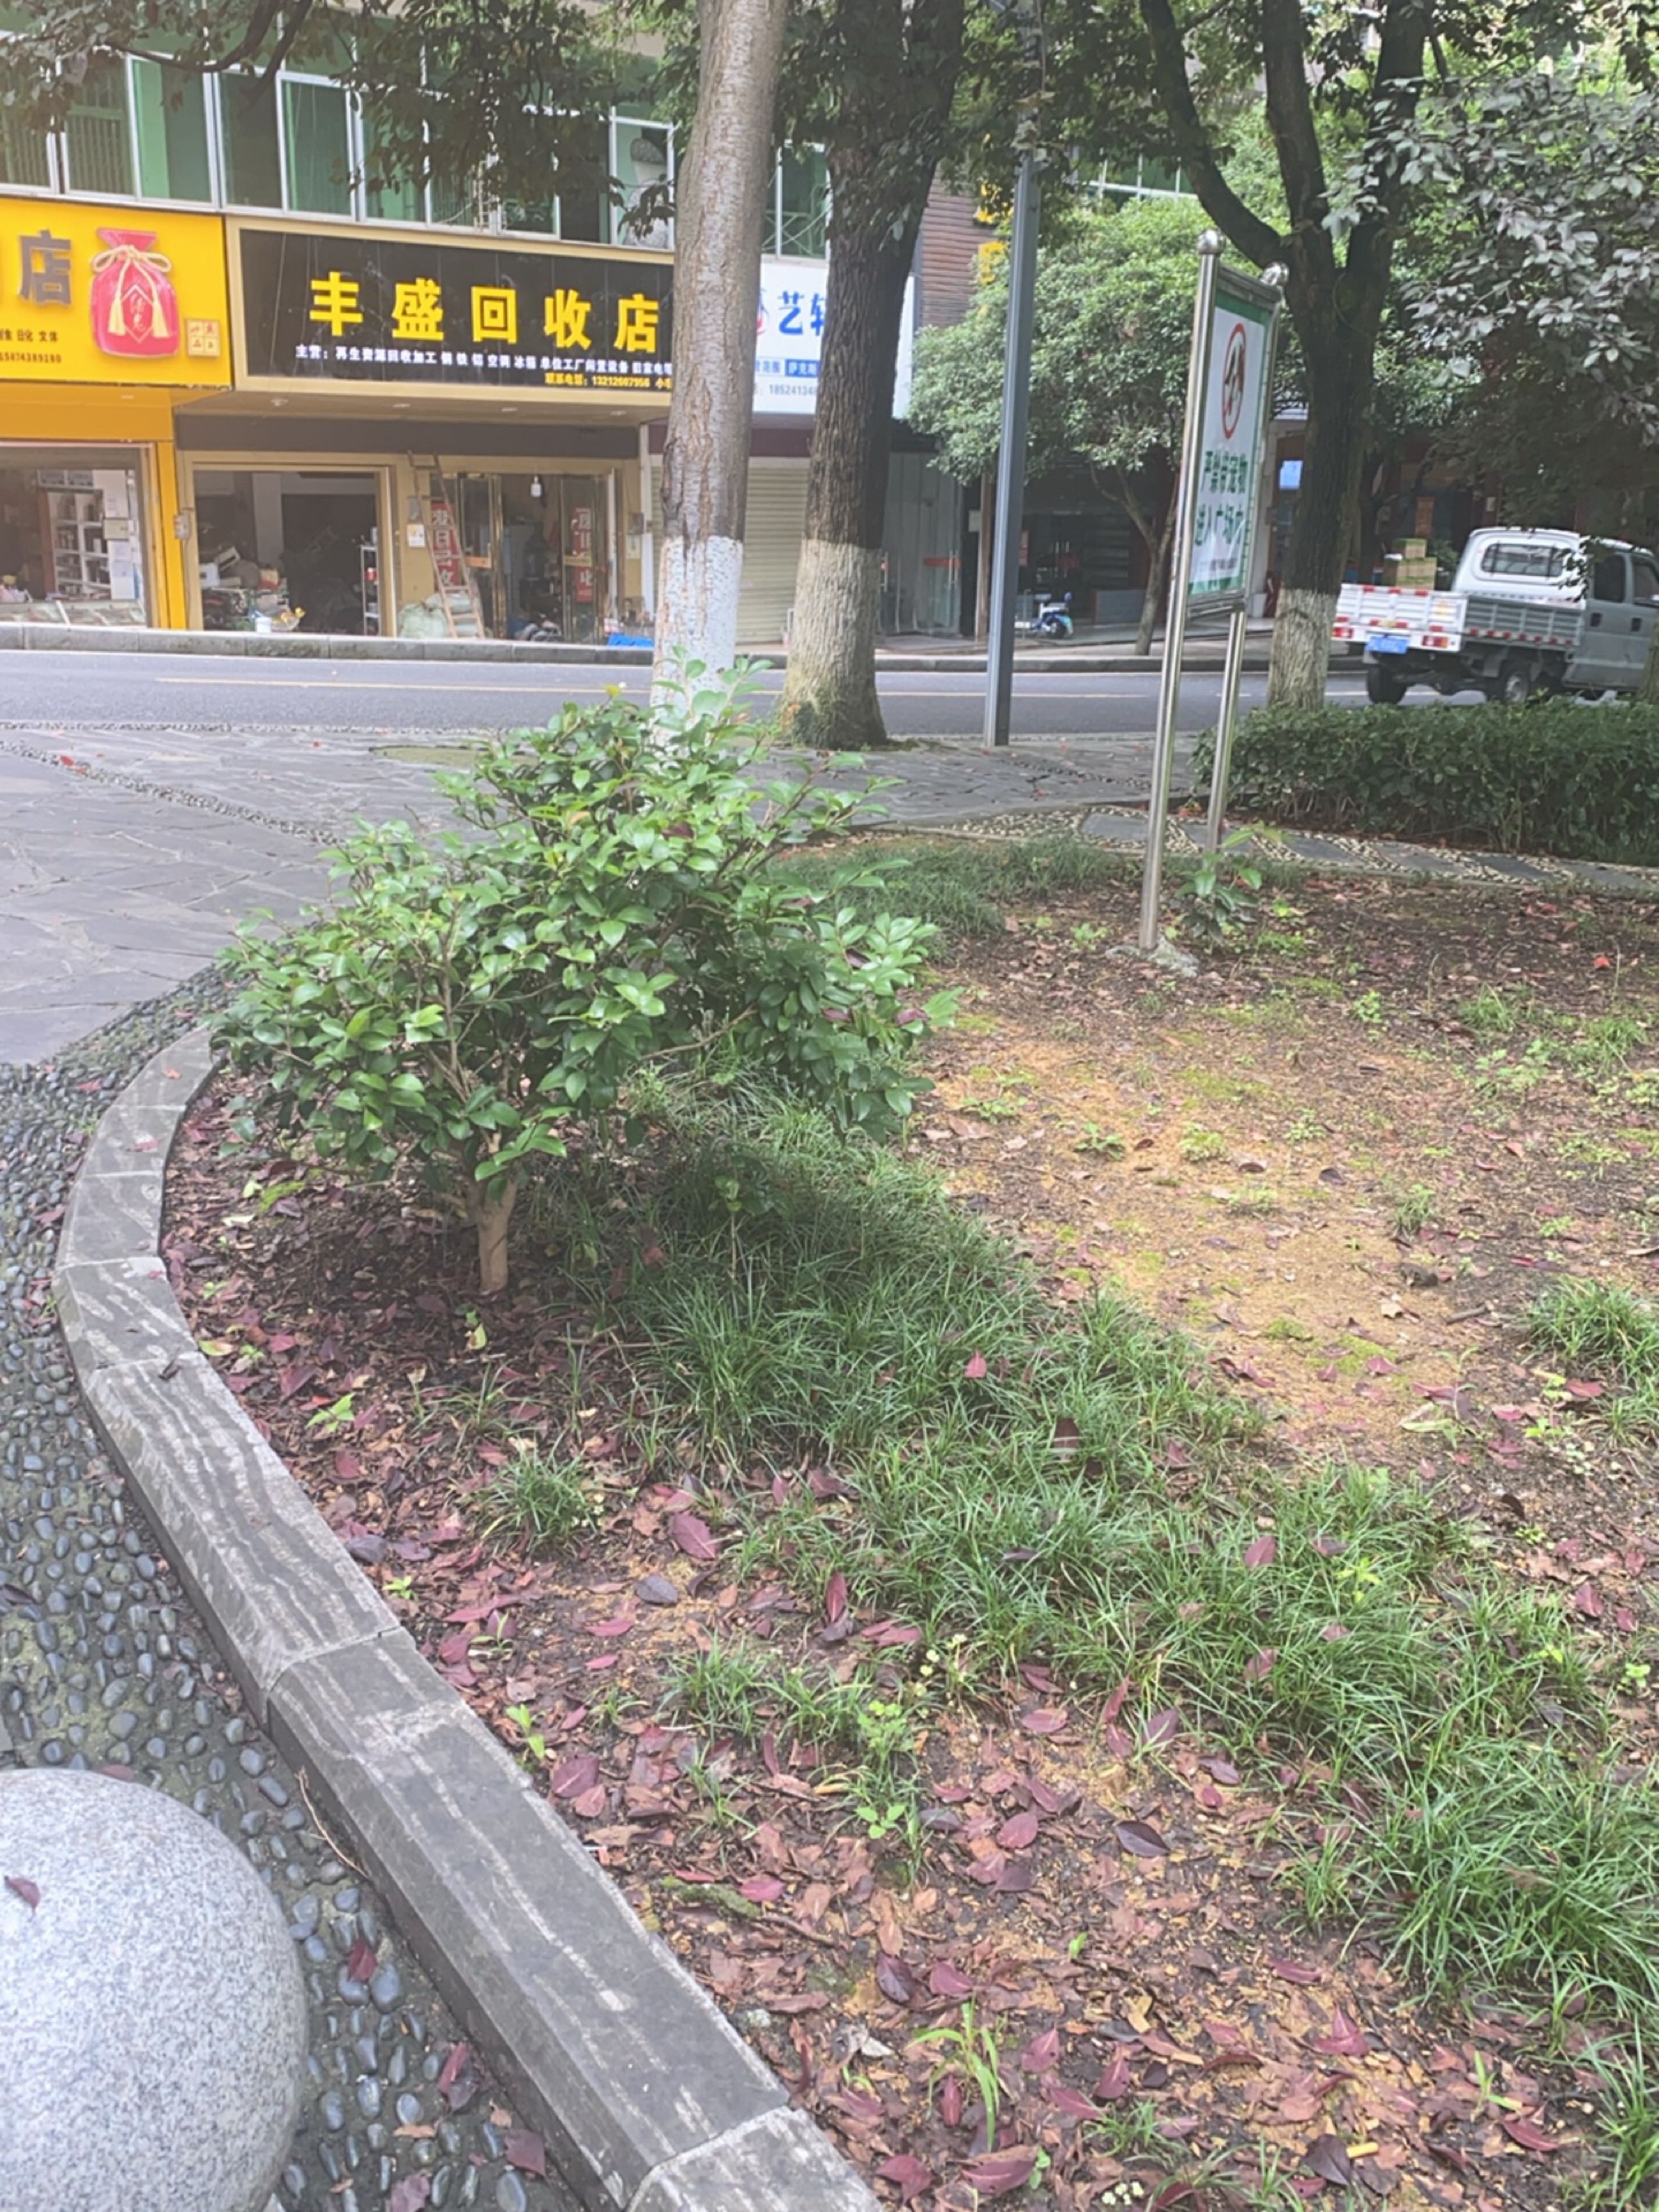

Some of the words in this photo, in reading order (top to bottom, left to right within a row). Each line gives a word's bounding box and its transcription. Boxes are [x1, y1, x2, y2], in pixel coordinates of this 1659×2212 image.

[18, 229, 72, 306] 店
[310, 271, 659, 353] 丰盛回收店
